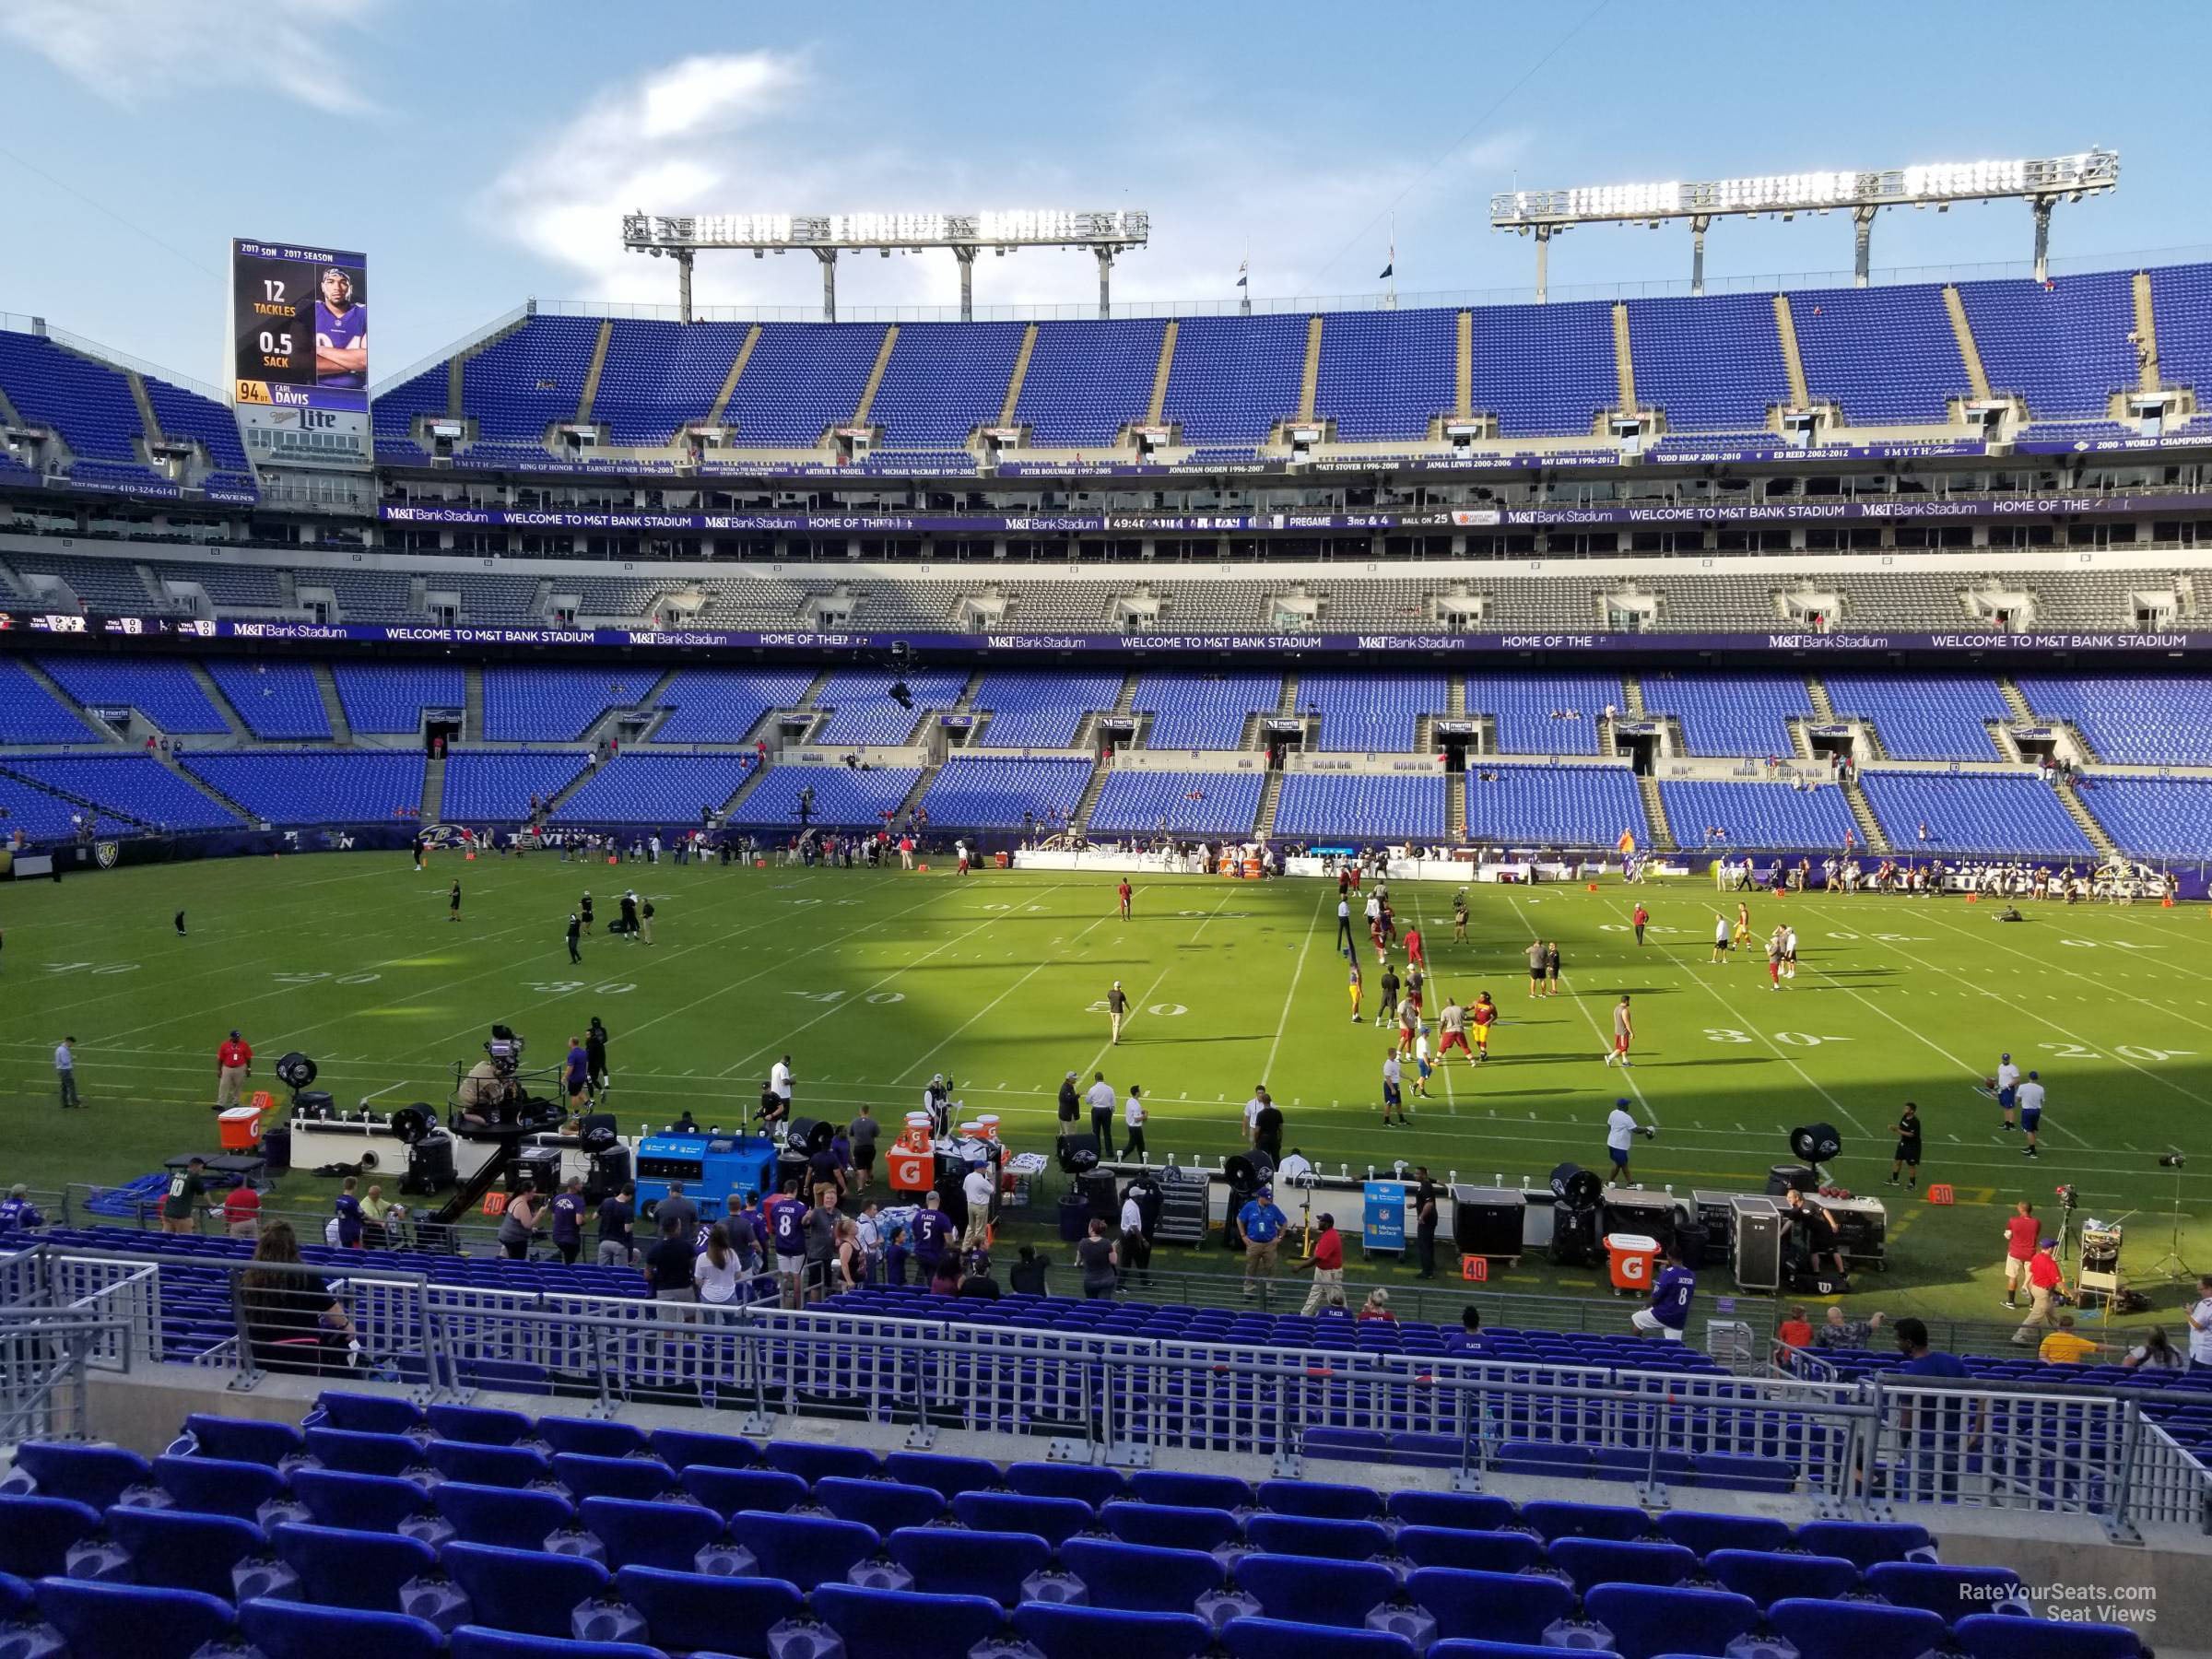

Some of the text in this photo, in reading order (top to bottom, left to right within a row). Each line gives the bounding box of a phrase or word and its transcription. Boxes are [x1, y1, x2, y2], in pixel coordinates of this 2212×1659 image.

[241, 243, 259, 254] 2017
[284, 249, 333, 262] 2017 SEASON
[264, 280, 285, 303] 12
[254, 302, 295, 317] TACKLES
[260, 332, 292, 355] 0.5
[264, 356, 288, 369] SACK
[241, 382, 259, 402] 94
[275, 385, 291, 394] CARL
[275, 393, 309, 406] DAVIS
[298, 409, 335, 430] Lite
[2125, 439, 2157, 448] WORLD
[520, 463, 538, 471] RING
[1630, 505, 1845, 520] WELCOME TO M&T BANK STADIUM
[1862, 503, 1976, 516] M&T Bank Stadium
[1993, 500, 2090, 512] HOME OF THE
[387, 508, 488, 523] M&T Bank Stadium
[503, 513, 691, 527] WELCOME TO M&T BANK STADIUM
[1290, 516, 1331, 526] PREGAME
[1434, 514, 1447, 524] 25
[1508, 511, 1537, 524] M&T
[1537, 511, 1565, 524] Bank
[1567, 511, 1613, 523] Stadium
[705, 517, 796, 529] M&T Bank Stadium
[809, 518, 859, 527] HOME OF
[1005, 518, 1097, 530] M&T Bank Stadium
[234, 623, 347, 638] M&T Bank Stadium
[385, 629, 594, 641] WELCOME TO M&T BANK STADIUM
[629, 632, 726, 645] M&T Bank Stadium
[761, 634, 814, 644] HOME OF
[988, 636, 1086, 647] M&T Bank Stadium
[1121, 638, 1321, 648] WELCOME TO M&T BANK STADIUM
[1358, 636, 1465, 649] M&T Bank Stadium
[1502, 636, 1593, 647] HOME OF THE
[1770, 636, 1888, 648] M&T Bank Stadium
[1932, 635, 2186, 647] WELCOME TO M&T BANK STADIUM
[900, 1160, 921, 1184] G
[170, 1178, 184, 1196] 10
[1935, 1187, 1950, 1203] 30
[779, 1215, 791, 1236] 8
[924, 1221, 932, 1239] 5
[1465, 1261, 1484, 1281] 40
[1622, 1257, 1642, 1279] G
[1678, 1287, 1688, 1305] 8
